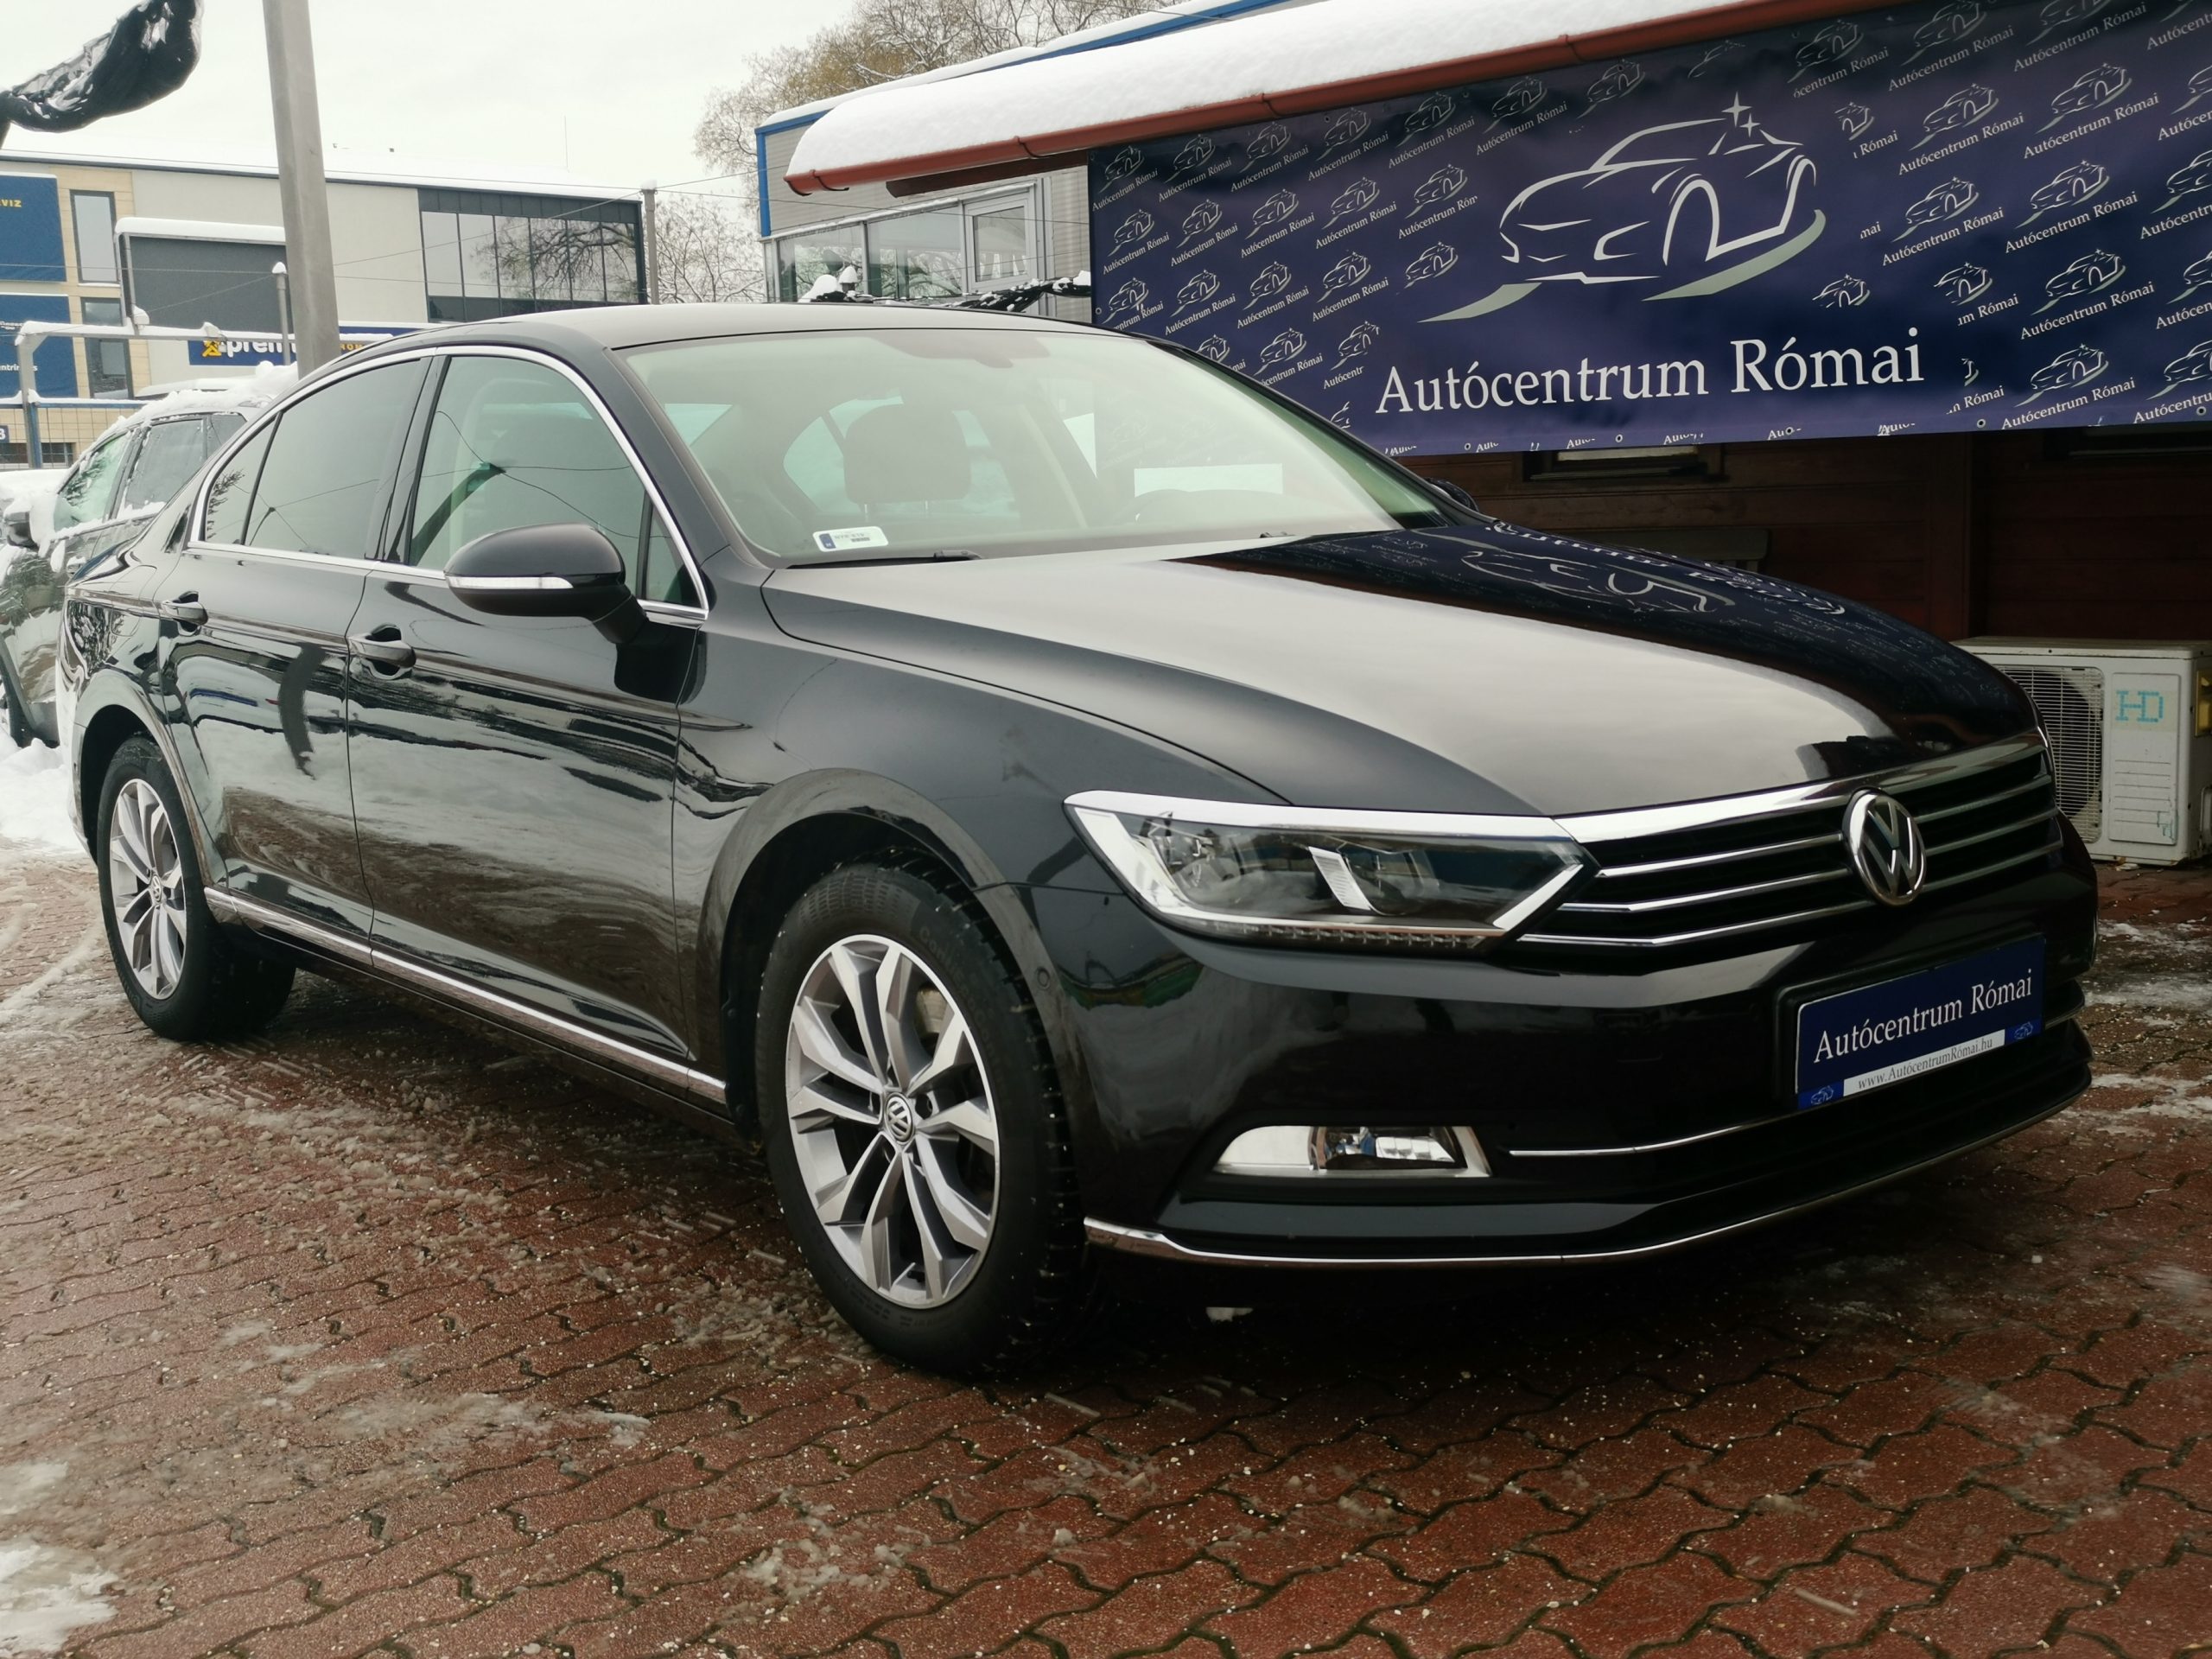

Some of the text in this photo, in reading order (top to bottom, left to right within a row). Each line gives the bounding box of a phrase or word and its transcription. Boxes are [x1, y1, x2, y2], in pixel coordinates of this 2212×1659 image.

[1850, 47, 1890, 73] Római
[1389, 116, 1475, 168] Autócentrum Római
[1477, 101, 1568, 156] Autócentrum Római
[1859, 130, 1898, 156] Római
[1899, 112, 2024, 175] Autócentrum Római
[2024, 92, 2159, 159] Autócentrum Római
[1231, 145, 1309, 192] Autócentrum Római
[1307, 131, 1389, 181] Autócentrum Római
[1092, 170, 1158, 212] Autócentrum Római
[1159, 159, 1231, 202] Autócentrum Római
[1171, 223, 1238, 267] Autócentrum Római
[1241, 213, 1315, 259] Autócentrum Római
[1315, 201, 1397, 250] Autócentrum Római
[1398, 206, 1456, 239] Autócentrum
[1883, 207, 2005, 266] Autócentrum Római
[2005, 191, 2139, 253] Autócentrum Római
[1103, 232, 1170, 275] Autócentrum Római
[1165, 294, 1236, 335] Autócentrum Római
[1236, 286, 1309, 329] Autócentrum Római
[1313, 276, 1389, 321] Autócentrum Római
[1978, 294, 2019, 318] Római
[2020, 281, 2155, 340] Autócentrum Római
[1297, 353, 1323, 372] Római
[1376, 327, 1925, 415] Autócentrum Római
[1964, 385, 2005, 409] Római
[2001, 377, 2136, 430] Autócentrum Római
[2115, 690, 2164, 723] HD
[1814, 968, 2032, 1064] Autócentrum Római
[1857, 1038, 1993, 1090] www.AutócentrumRómai.hu
